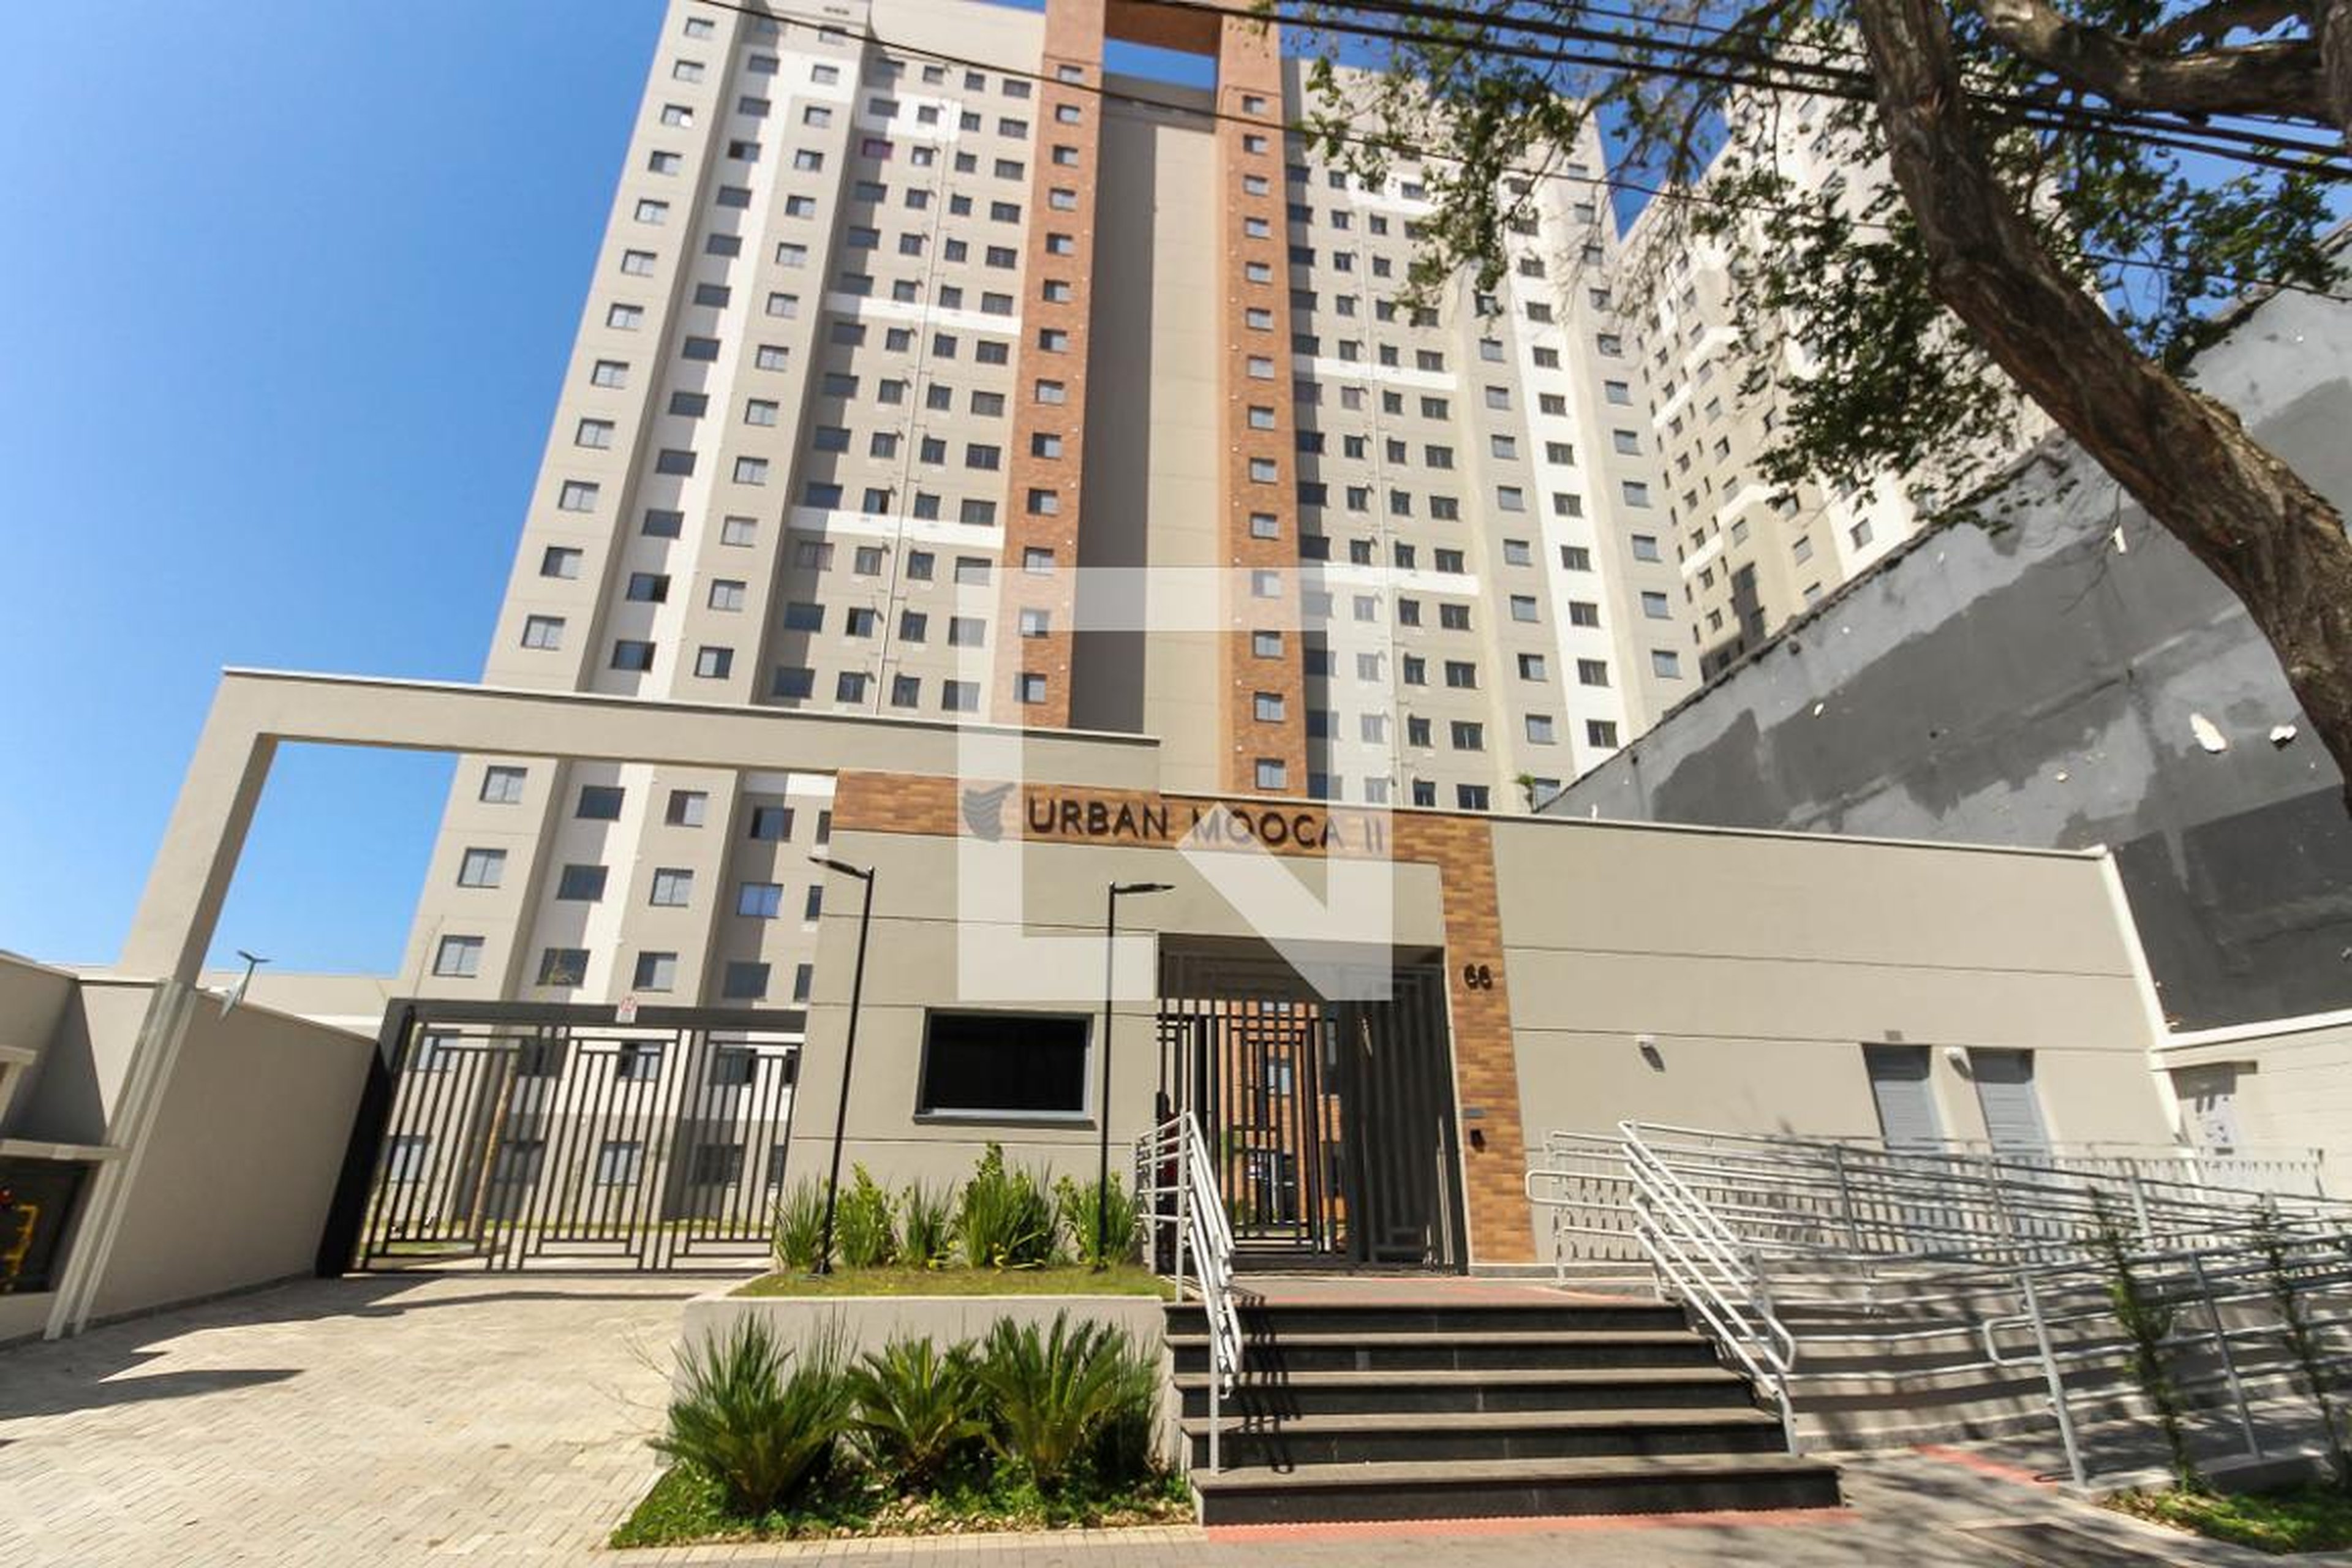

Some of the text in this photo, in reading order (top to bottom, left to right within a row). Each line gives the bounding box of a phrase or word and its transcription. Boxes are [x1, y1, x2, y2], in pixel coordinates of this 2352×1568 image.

[1028, 797, 1383, 852] URBAN MOOCA II
